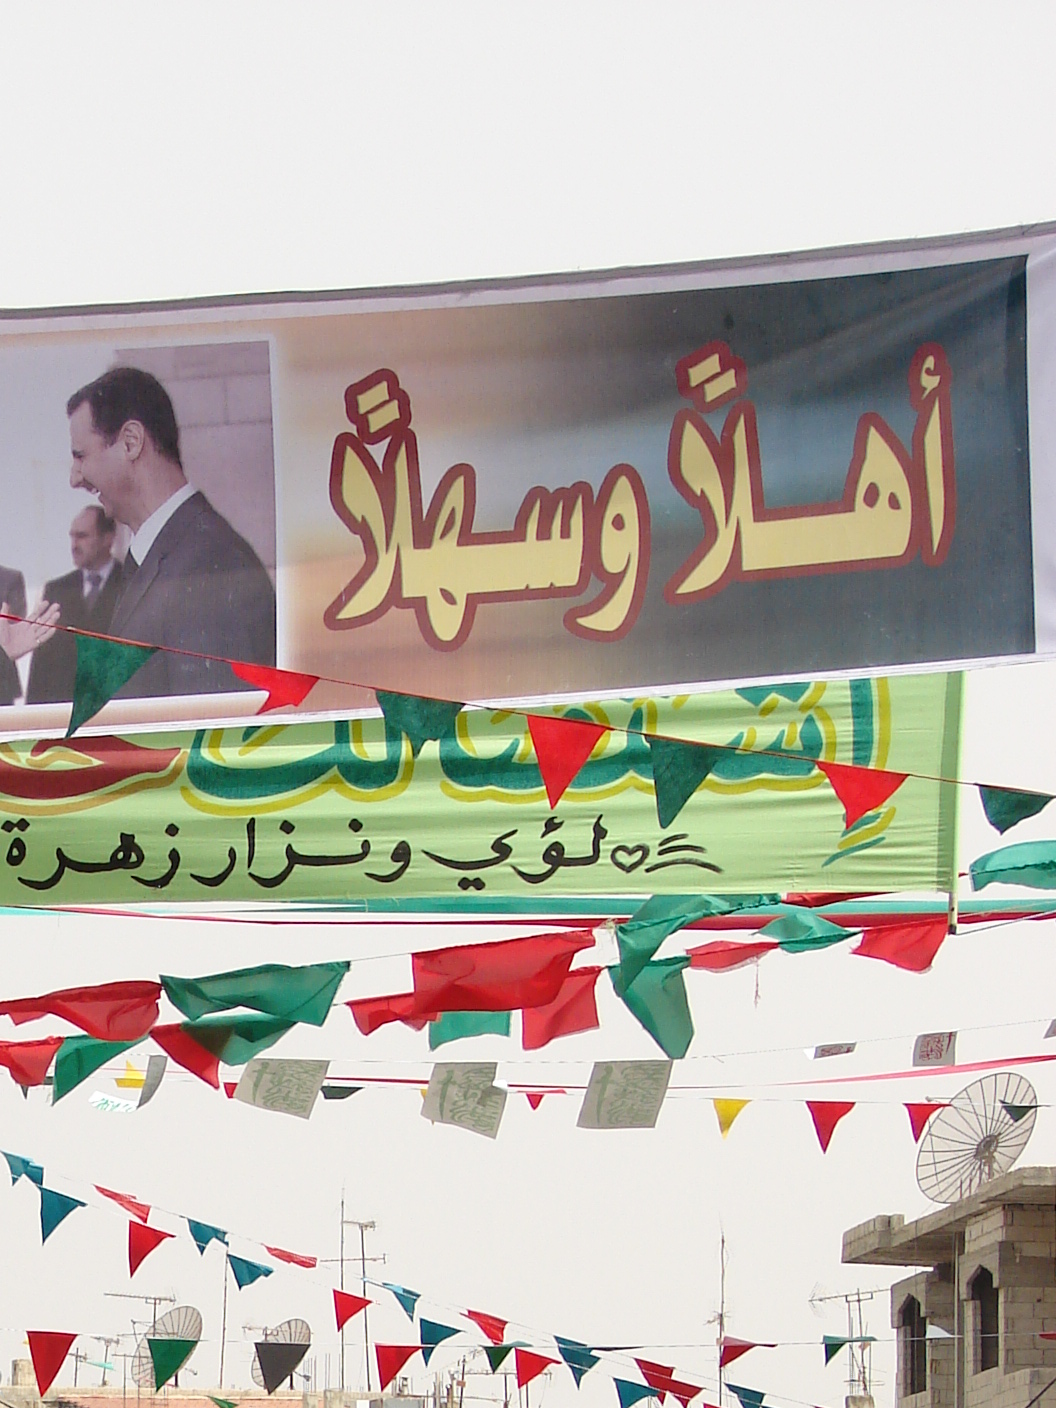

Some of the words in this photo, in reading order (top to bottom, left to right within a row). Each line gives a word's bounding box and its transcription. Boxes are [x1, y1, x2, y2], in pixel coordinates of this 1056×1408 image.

[325, 368, 650, 652] وسهلاً
[666, 341, 956, 605] أهلاً
[0, 817, 182, 890] زهرة
[421, 813, 609, 891] لؤي
